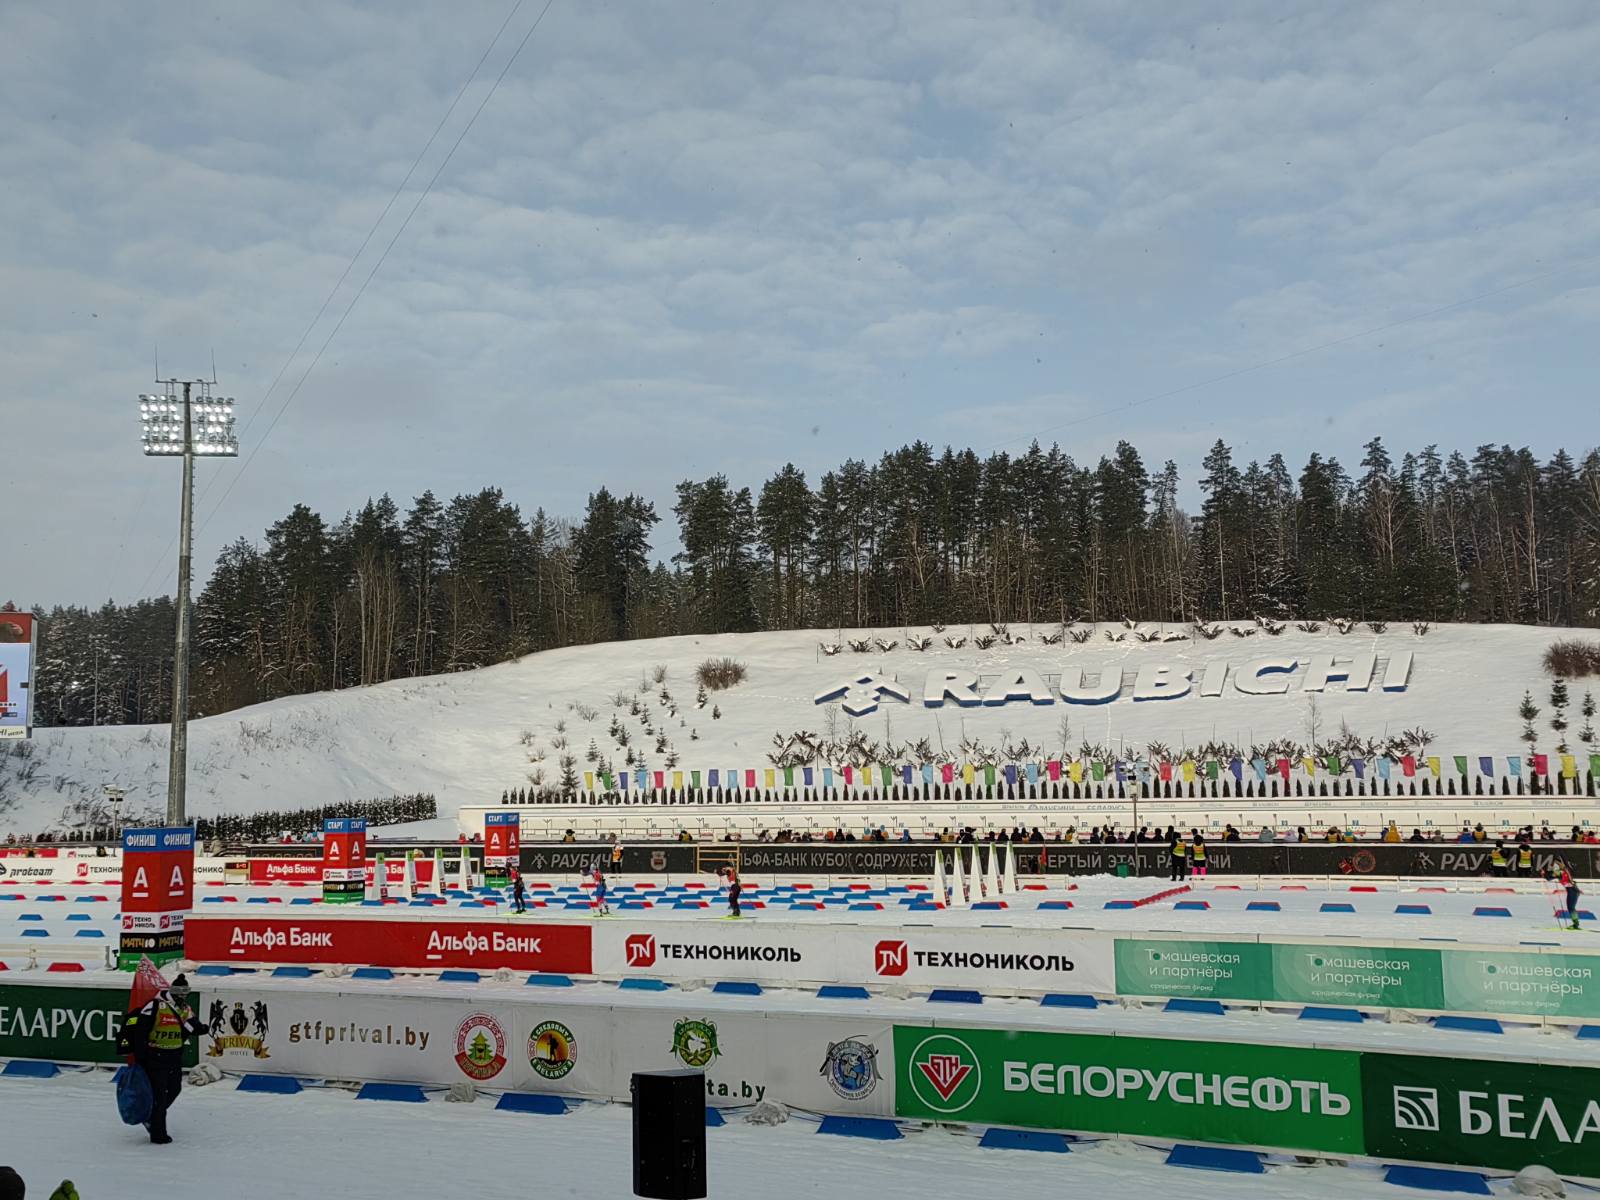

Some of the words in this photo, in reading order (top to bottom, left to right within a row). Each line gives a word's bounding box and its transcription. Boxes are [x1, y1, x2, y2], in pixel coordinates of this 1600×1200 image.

[922, 650, 1414, 708] RAUBICHI
[327, 821, 343, 830] СТАРТ
[350, 821, 363, 829] СТАРТ
[126, 834, 157, 847] ФИНИШ
[163, 833, 191, 846] ФИНИШ
[551, 853, 622, 868] РАУБИЧ
[811, 853, 849, 867] КУБОК
[855, 853, 953, 869] СОДРУЖЕСТА
[9, 867, 54, 878] proteam
[266, 863, 294, 876] Альфа
[295, 863, 316, 874] Банк
[230, 927, 285, 951] Альфа
[290, 927, 333, 947] Банк
[427, 930, 487, 956] Альфа
[492, 932, 542, 953] Банк
[660, 944, 802, 963] ТЕХНОНИКОЛЬ
[914, 951, 1075, 971] ТЕХНОНИКОЛЬ
[1144, 948, 1241, 964] Томашевская
[1305, 954, 1410, 971] Томашевская
[1477, 960, 1592, 978] Томашевская
[1149, 966, 1158, 976] и
[1163, 966, 1233, 983] партнёры
[1311, 972, 1320, 982] и
[1325, 972, 1402, 989] партнёры
[1500, 980, 1583, 1001] партнёры
[0, 1006, 124, 1042] ЕЛАРУСБ
[155, 1030, 180, 1040] ТРЕН
[223, 1036, 256, 1050] PRIVAL
[289, 1020, 430, 1051] gtfprival.by
[706, 1079, 766, 1102] ta.by
[1003, 1061, 1352, 1118] БЕЛОРУСНЕФТЬ
